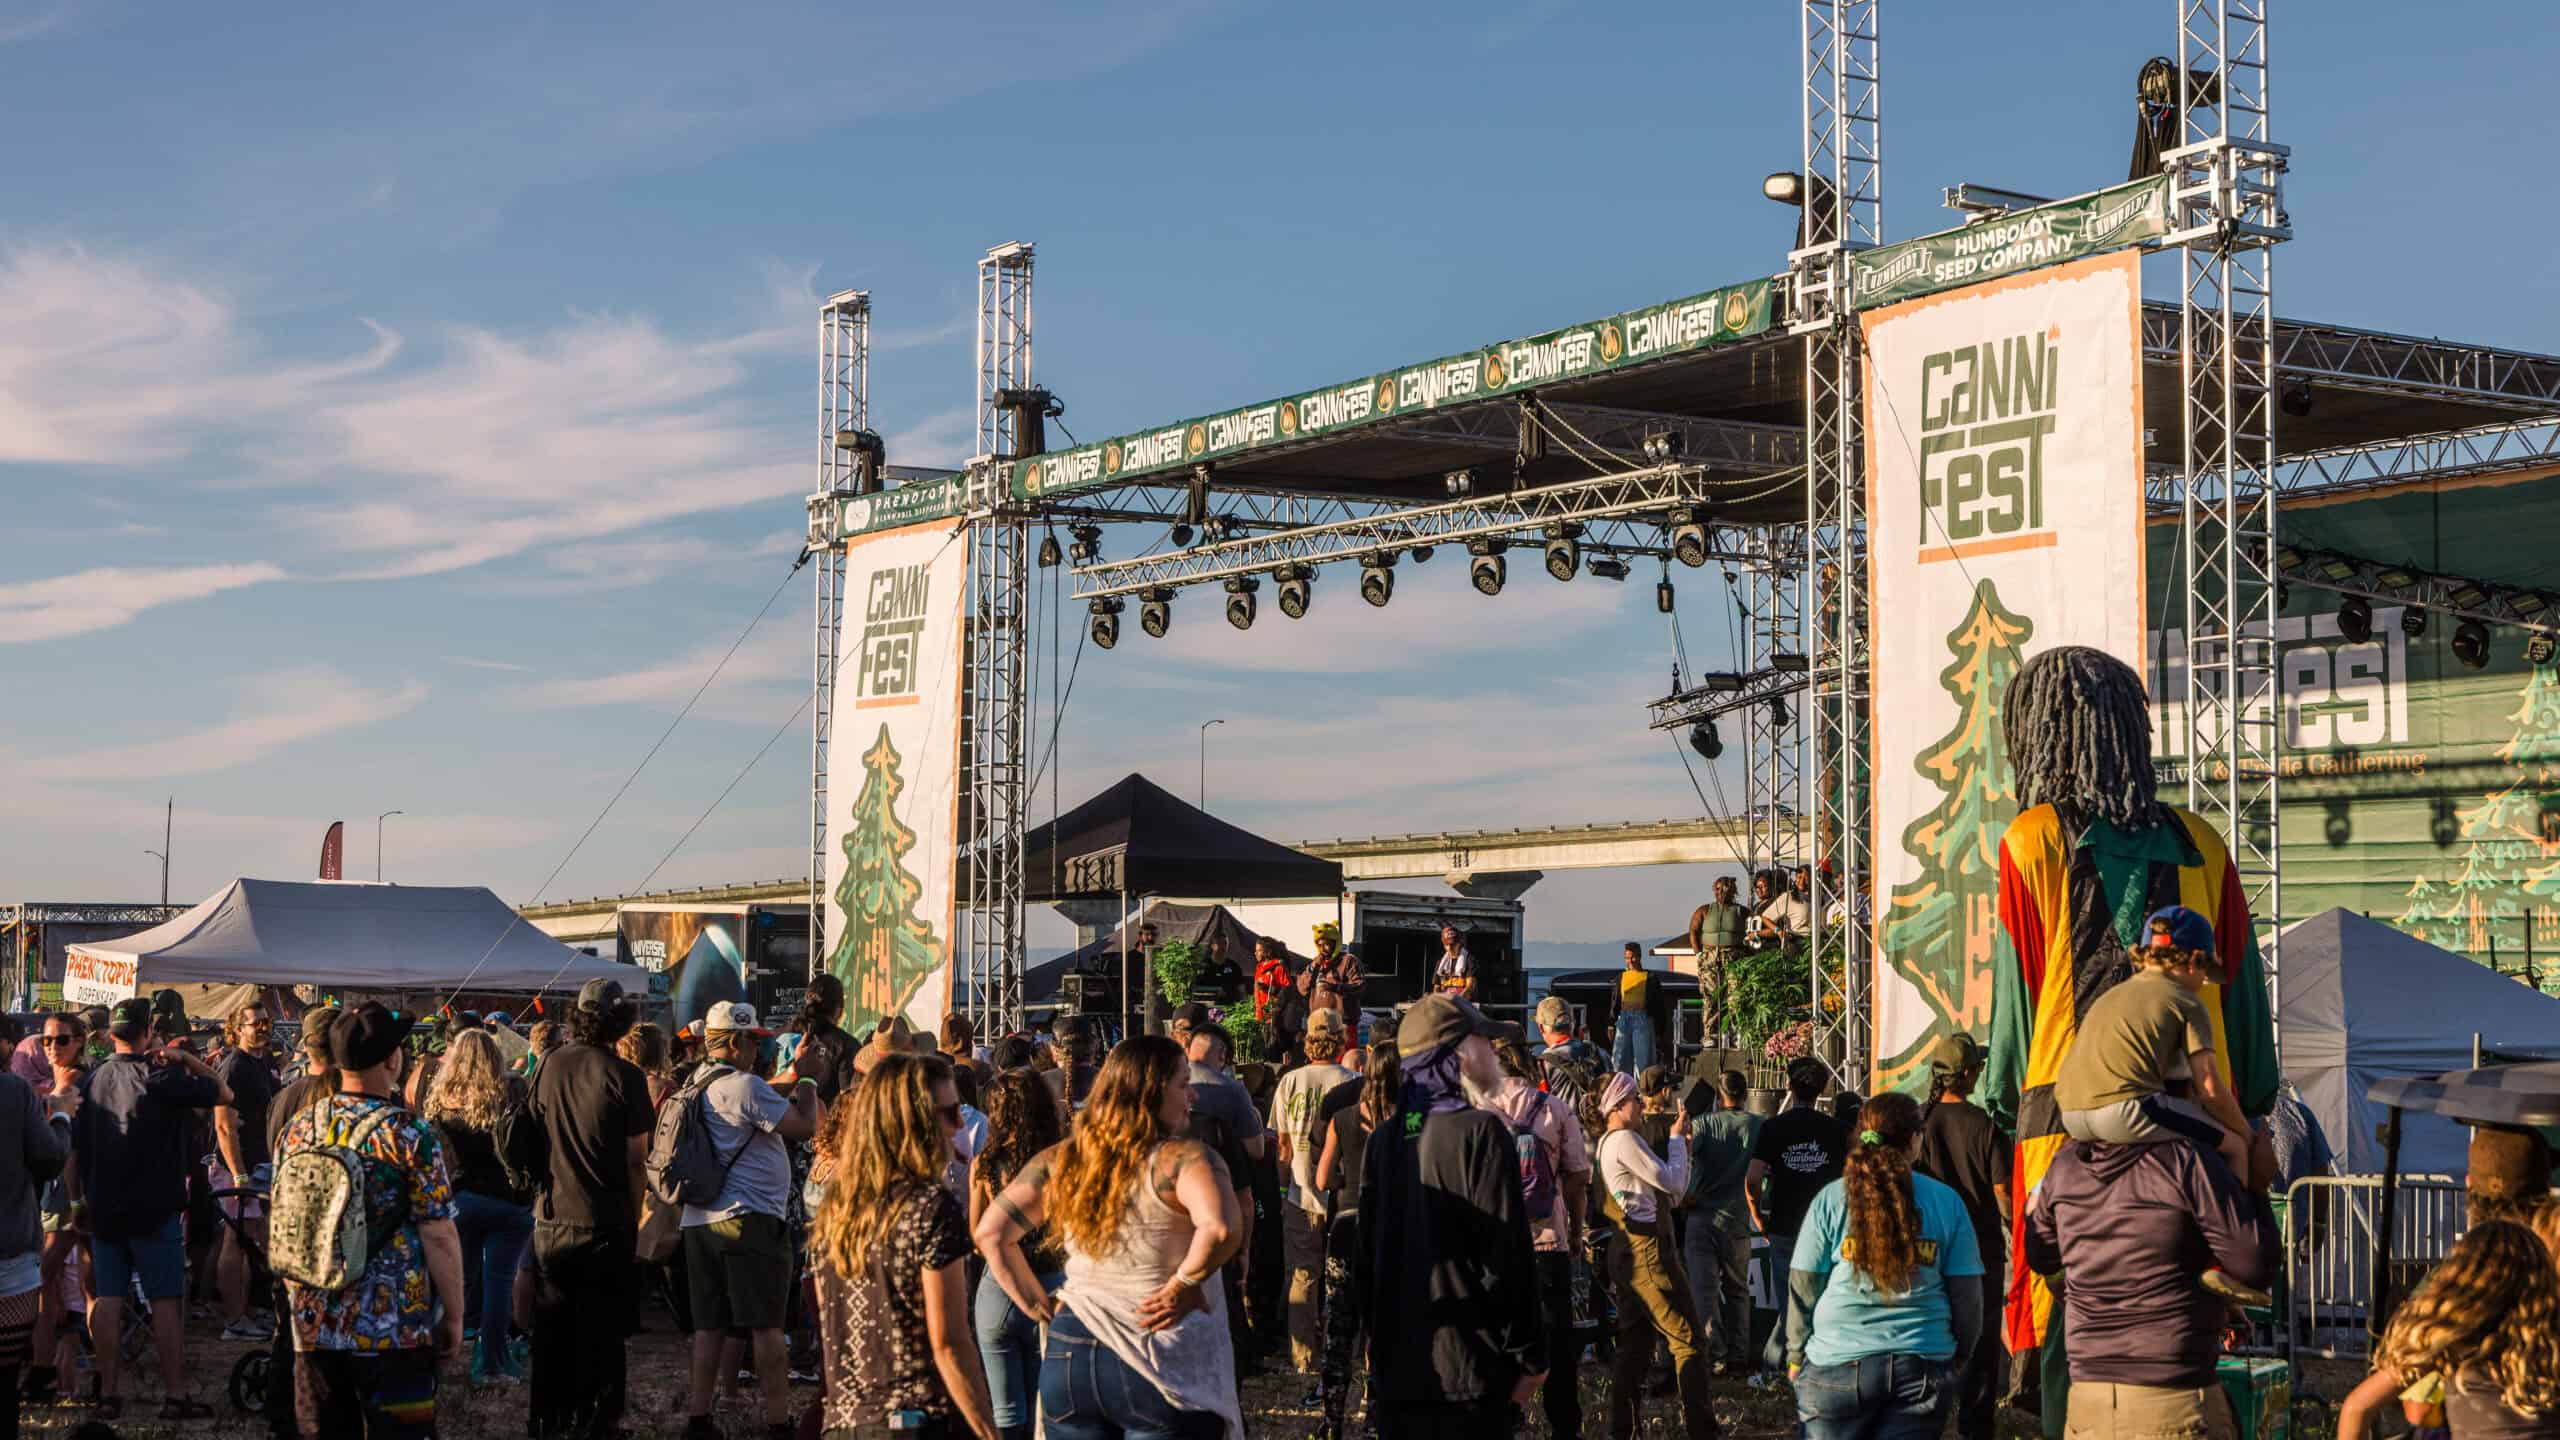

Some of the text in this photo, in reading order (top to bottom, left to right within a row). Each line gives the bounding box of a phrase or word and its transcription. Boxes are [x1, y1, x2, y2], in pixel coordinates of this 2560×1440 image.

[1955, 214, 2057, 256] HUMBOLDT
[1934, 233, 2075, 283] SEED COMPANY
[875, 482, 960, 512] PHENOTOPA
[2308, 749, 2428, 777] Gathering
